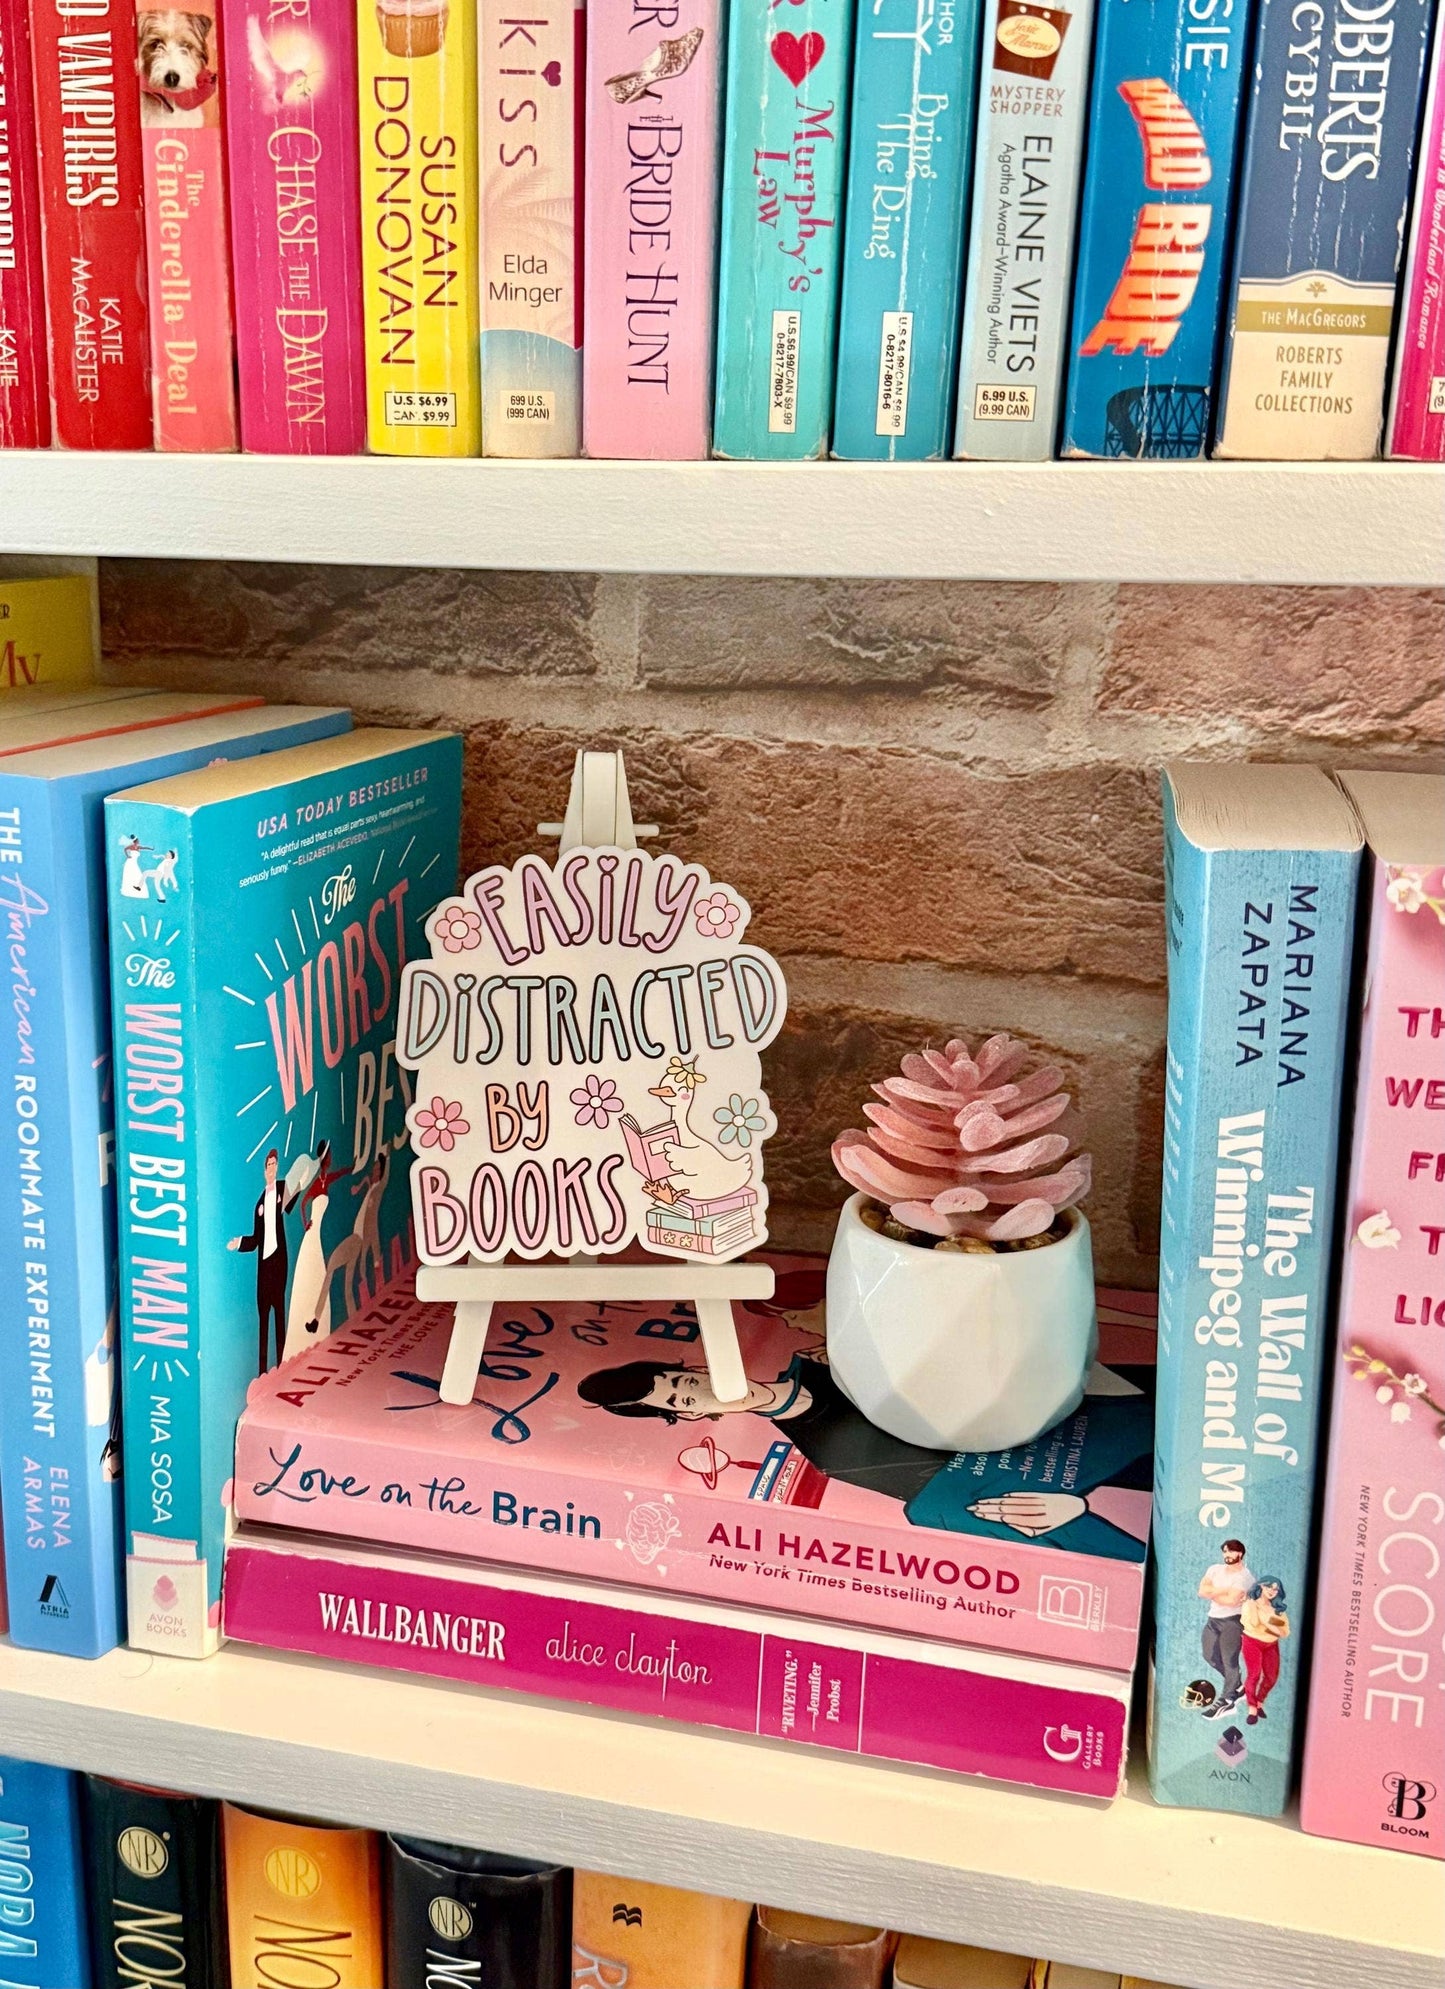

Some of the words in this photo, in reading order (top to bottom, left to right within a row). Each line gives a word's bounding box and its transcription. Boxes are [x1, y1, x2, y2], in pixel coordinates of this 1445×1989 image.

[57, 30, 120, 208] VAMPIRES
[990, 85, 1066, 102] MYSTERY
[990, 100, 1063, 117] SHOPPER
[876, 113, 916, 174] The
[917, 93, 949, 180] Bring
[999, 142, 1016, 195] Agatha
[186, 170, 205, 207] The
[267, 126, 323, 257] CHASE
[374, 76, 416, 365] DONOVAN
[420, 136, 458, 307] SUSAN
[624, 122, 683, 256] BRIDE
[753, 148, 791, 229] Law
[778, 97, 835, 293] Murphy's
[863, 168, 914, 260] Ring
[1015, 135, 1053, 262] ELAINE
[154, 138, 191, 327] Cinderella
[503, 255, 549, 274] Elda
[288, 266, 310, 301] THE
[488, 283, 563, 308] Minger
[1077, 203, 1212, 357] RIDE
[71, 256, 100, 403] MACALISTER
[99, 297, 124, 365] KATIE
[625, 262, 679, 395] HUNT
[986, 318, 1004, 364] Author
[1006, 278, 1042, 373] VIETS
[1261, 311, 1281, 325] THE
[164, 340, 198, 415] Deal
[275, 306, 329, 428] DAWN
[882, 334, 895, 410] 0-8217-8016-6
[1276, 346, 1343, 365] ROBERTS
[1280, 370, 1333, 388] FAMILY
[394, 395, 416, 405] U.S.
[418, 396, 448, 407] $6.99
[423, 411, 449, 422] $9.99
[507, 407, 524, 419] (999
[527, 408, 550, 420] CAN)
[511, 395, 525, 405] 699
[528, 396, 546, 406] U.S.
[978, 404, 1004, 416] (9.99
[1005, 405, 1030, 417] CAN)
[982, 390, 1006, 401] 6.99
[1008, 391, 1029, 402] U.S.
[1255, 394, 1353, 414] COLLECTIONS
[0, 807, 23, 864] THE
[257, 812, 288, 839] USA
[296, 795, 343, 825] TODAY
[349, 767, 428, 807] BESTSELLER
[239, 871, 270, 888] seriously
[322, 863, 358, 926] The
[0, 872, 49, 1065] American
[125, 953, 176, 988] The
[265, 877, 409, 1115] WORST
[1235, 902, 1273, 1068] ZAPATA
[1277, 885, 1319, 1088] MARIANA
[124, 1002, 185, 1143] WORST
[485, 1080, 549, 1154] BY
[13, 1074, 47, 1251] ROOMMATE
[128, 1151, 188, 1247] BEST
[418, 1154, 628, 1257] BOOKS
[1195, 1109, 1265, 1349] Winnipeg
[1264, 1186, 1315, 1277] The
[131, 1256, 189, 1349] MAN
[26, 1261, 55, 1438] EXPERIMENT
[335, 1366, 364, 1388] New
[359, 1347, 385, 1367] York
[380, 1323, 412, 1347] Times
[389, 1343, 414, 1360] THE
[411, 1319, 439, 1343] LOVE
[1257, 1294, 1308, 1402] Wall
[150, 1395, 172, 1444] MIA
[275, 1365, 340, 1408] ALI
[1203, 1361, 1247, 1450] and
[1060, 1448, 1082, 1490] CHRISTINA
[1253, 1413, 1299, 1466] of
[23, 1456, 46, 1550] ARMAS
[50, 1466, 73, 1548] ELENA
[151, 1453, 173, 1523] SOSA
[254, 1443, 369, 1502] Love
[380, 1481, 412, 1507] on
[419, 1476, 482, 1516] the
[492, 1490, 602, 1539] Brain
[1199, 1462, 1246, 1528] Me
[1359, 1484, 1370, 1514] NEW
[707, 1522, 762, 1552] ALI
[778, 1532, 1020, 1595] HAZELWOOD
[1356, 1515, 1368, 1547] YORK
[709, 1554, 748, 1572] New
[754, 1561, 791, 1581] York
[798, 1569, 846, 1590] Times
[851, 1577, 948, 1610] Bestselling
[954, 1596, 1016, 1619] Author
[1352, 1549, 1366, 1587] TIMES
[146, 1622, 187, 1638] BOOKS
[149, 1613, 183, 1626] AVON
[1091, 1585, 1104, 1632] BERKLEY
[1346, 1590, 1362, 1667] BESTSELLING
[1364, 1486, 1445, 1728] SCORE
[319, 1592, 506, 1661] WALLBANGER
[545, 1620, 607, 1667] alice
[615, 1632, 712, 1702] clayton
[826, 1679, 841, 1723] Probst
[1341, 1669, 1354, 1719] AUTHOR
[1082, 1724, 1095, 1770] GALLERY
[1208, 1769, 1251, 1784] AVON
[1381, 1823, 1430, 1839] BLOOM
